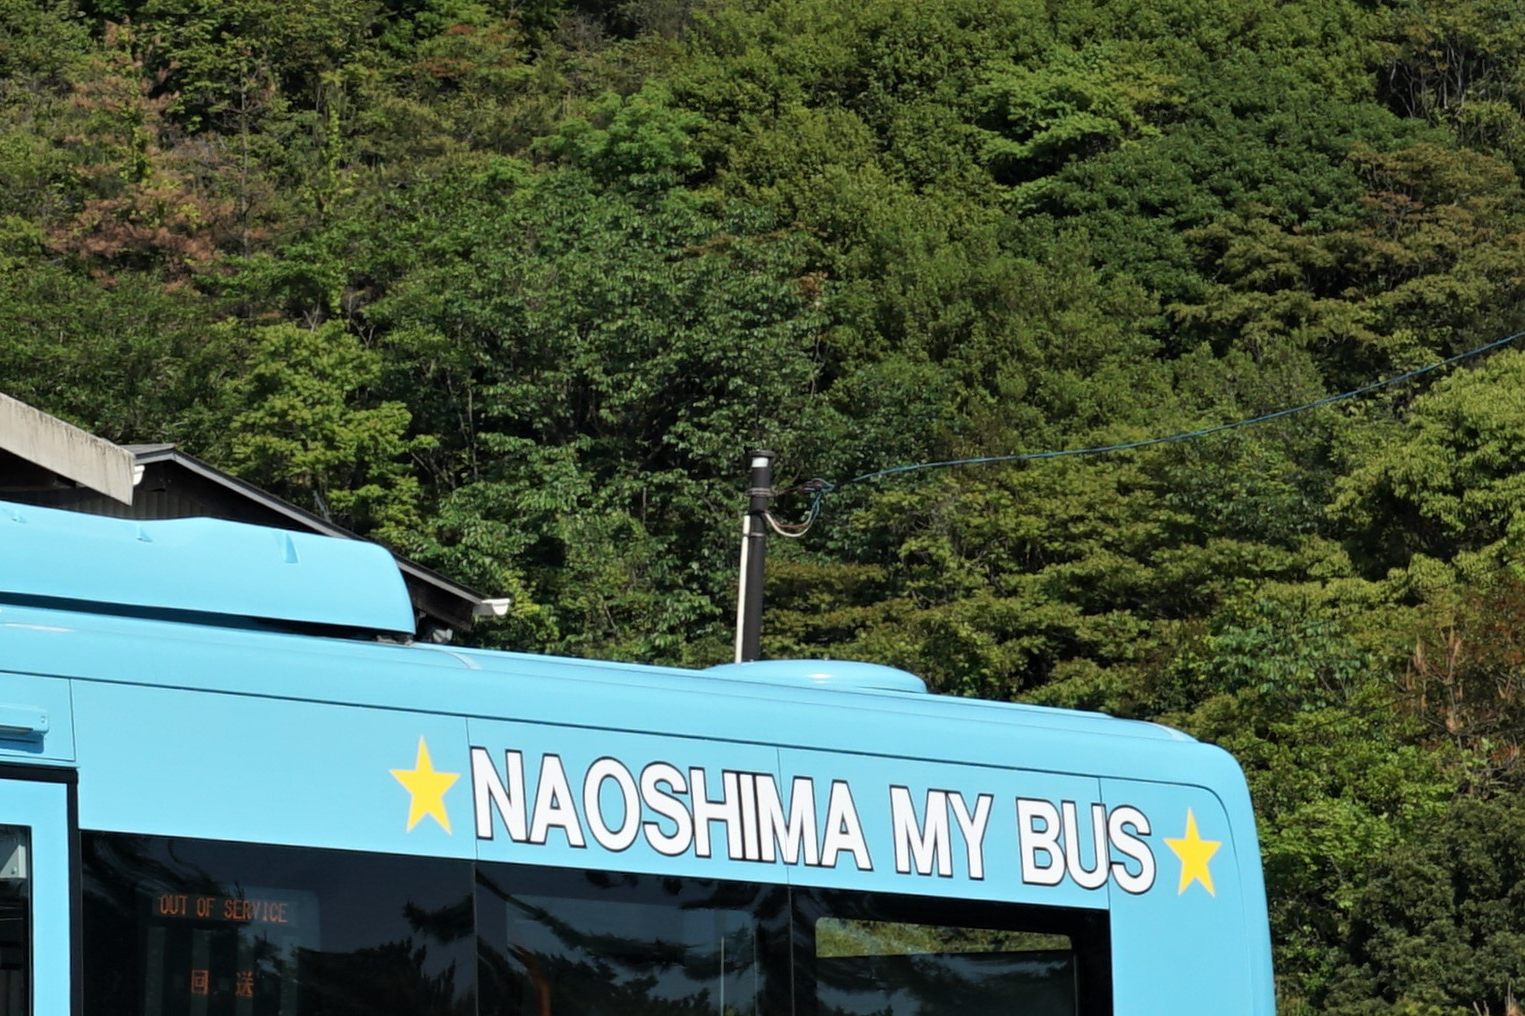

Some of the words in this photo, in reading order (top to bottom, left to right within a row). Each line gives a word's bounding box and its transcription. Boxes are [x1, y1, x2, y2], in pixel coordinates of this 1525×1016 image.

[470, 745, 874, 872] NAOSHIMA
[889, 784, 994, 881] MY
[1015, 796, 1156, 895] BUS
[160, 895, 187, 915] OUT
[197, 897, 214, 917] OF
[224, 899, 288, 923] SERVICE
